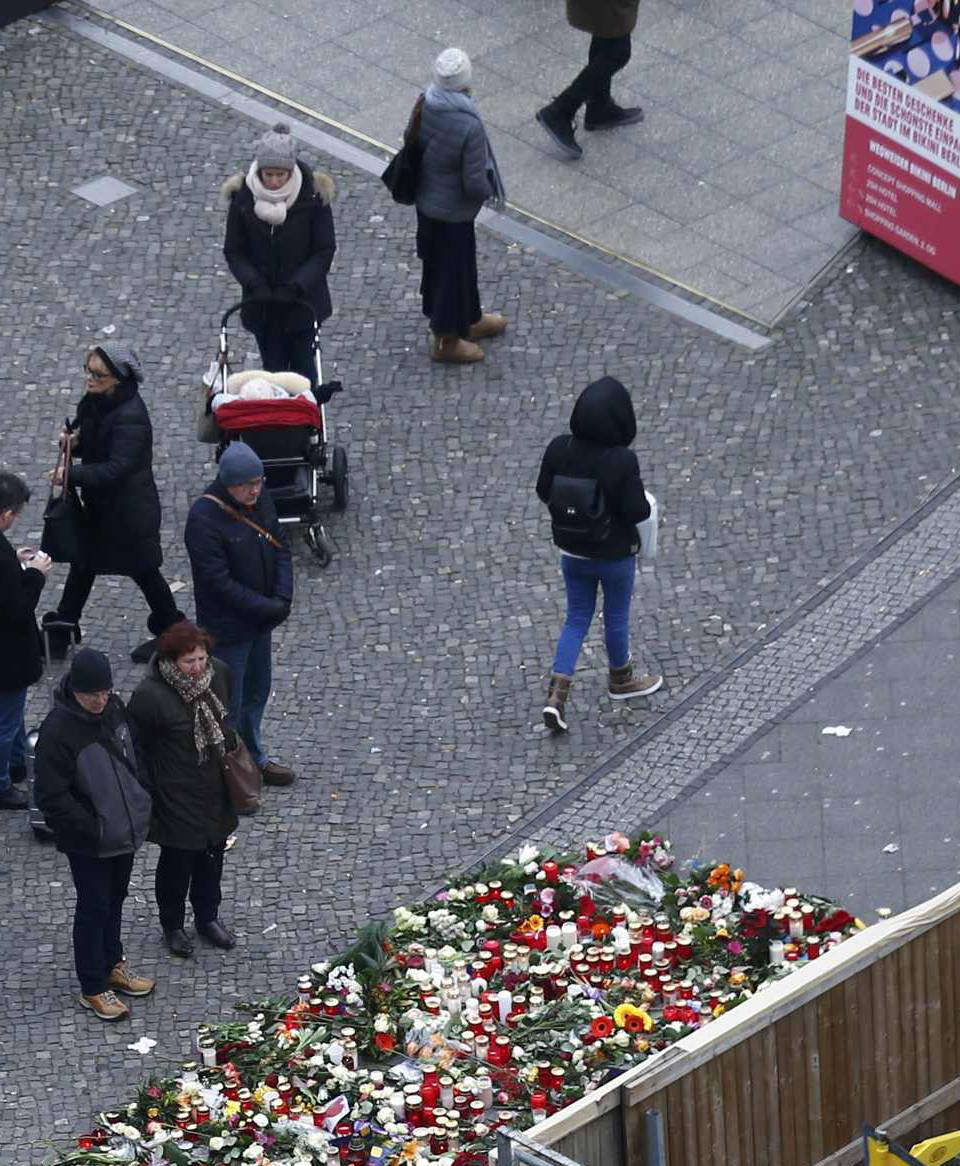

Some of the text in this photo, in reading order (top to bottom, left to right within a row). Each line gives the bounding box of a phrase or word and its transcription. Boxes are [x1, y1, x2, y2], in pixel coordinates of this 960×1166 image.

[856, 81, 873, 100] UND
[875, 93, 887, 109] DIE
[857, 67, 953, 132] DIE BESTEN GESCHENKE
[854, 98, 870, 117] DER
[872, 107, 898, 131] STADT
[900, 123, 911, 140] IM
[913, 131, 939, 155] BIKINI
